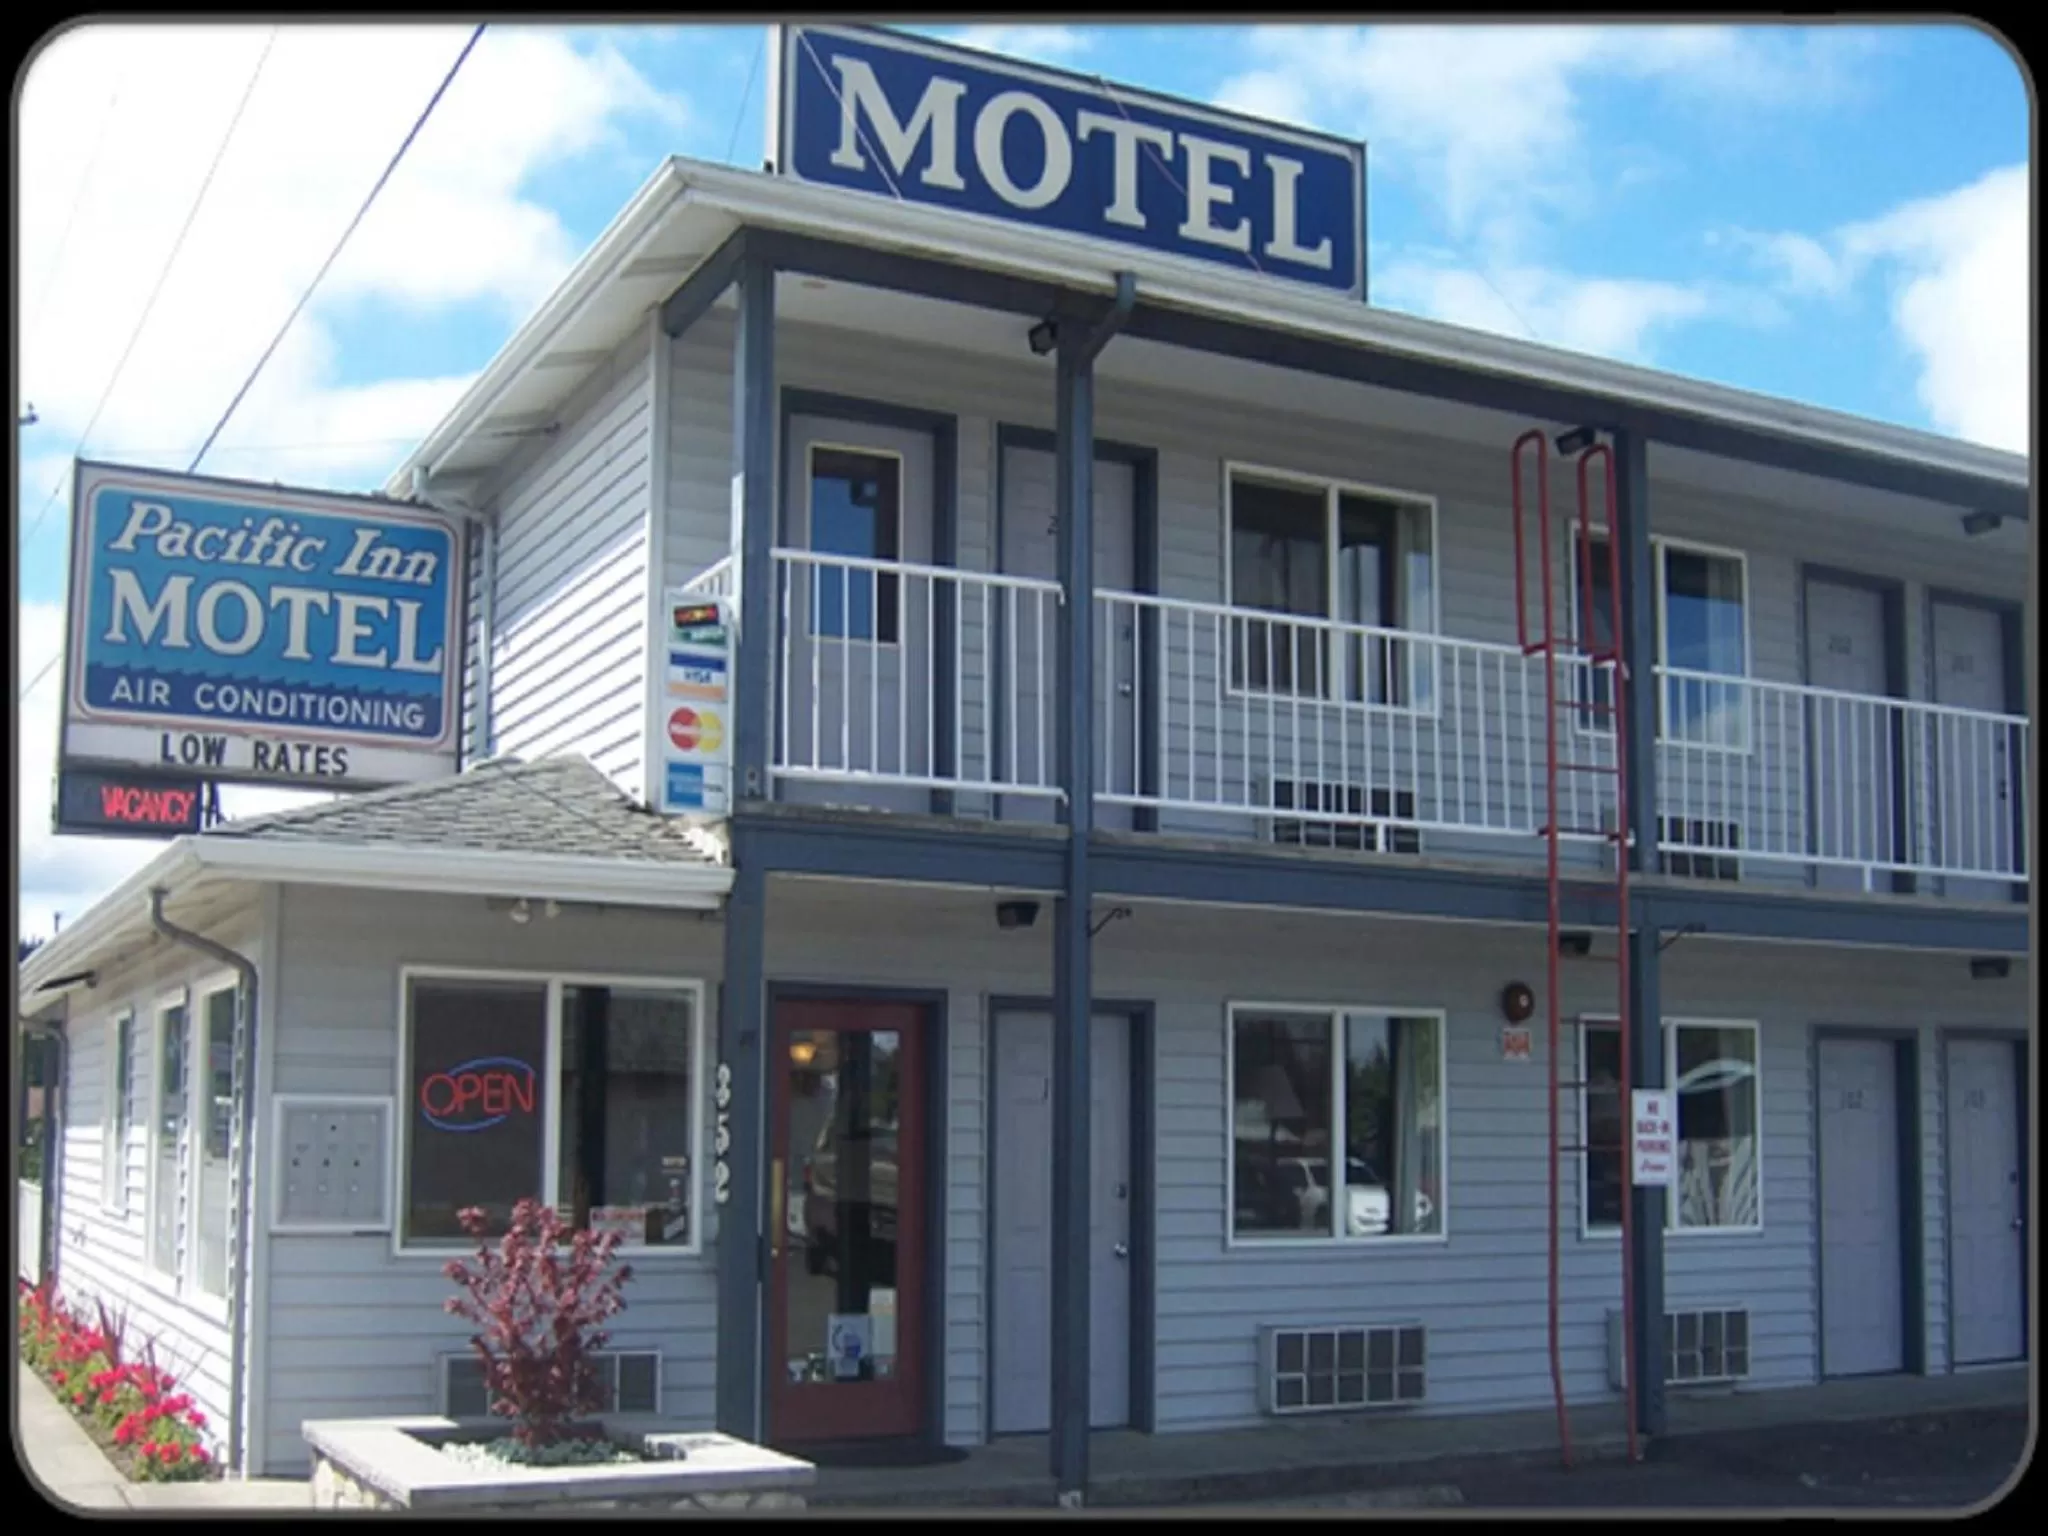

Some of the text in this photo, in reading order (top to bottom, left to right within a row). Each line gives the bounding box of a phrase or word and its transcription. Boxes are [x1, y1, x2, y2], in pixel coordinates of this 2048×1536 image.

[829, 54, 1332, 270] MOTEL
[108, 501, 438, 585] Pacific Inn
[104, 568, 444, 674] MOTEL
[111, 676, 425, 730] AIR CONDITIONING
[161, 732, 348, 775] LOW RATES
[101, 785, 196, 824] VACANCY
[421, 1071, 534, 1116] OPEN
